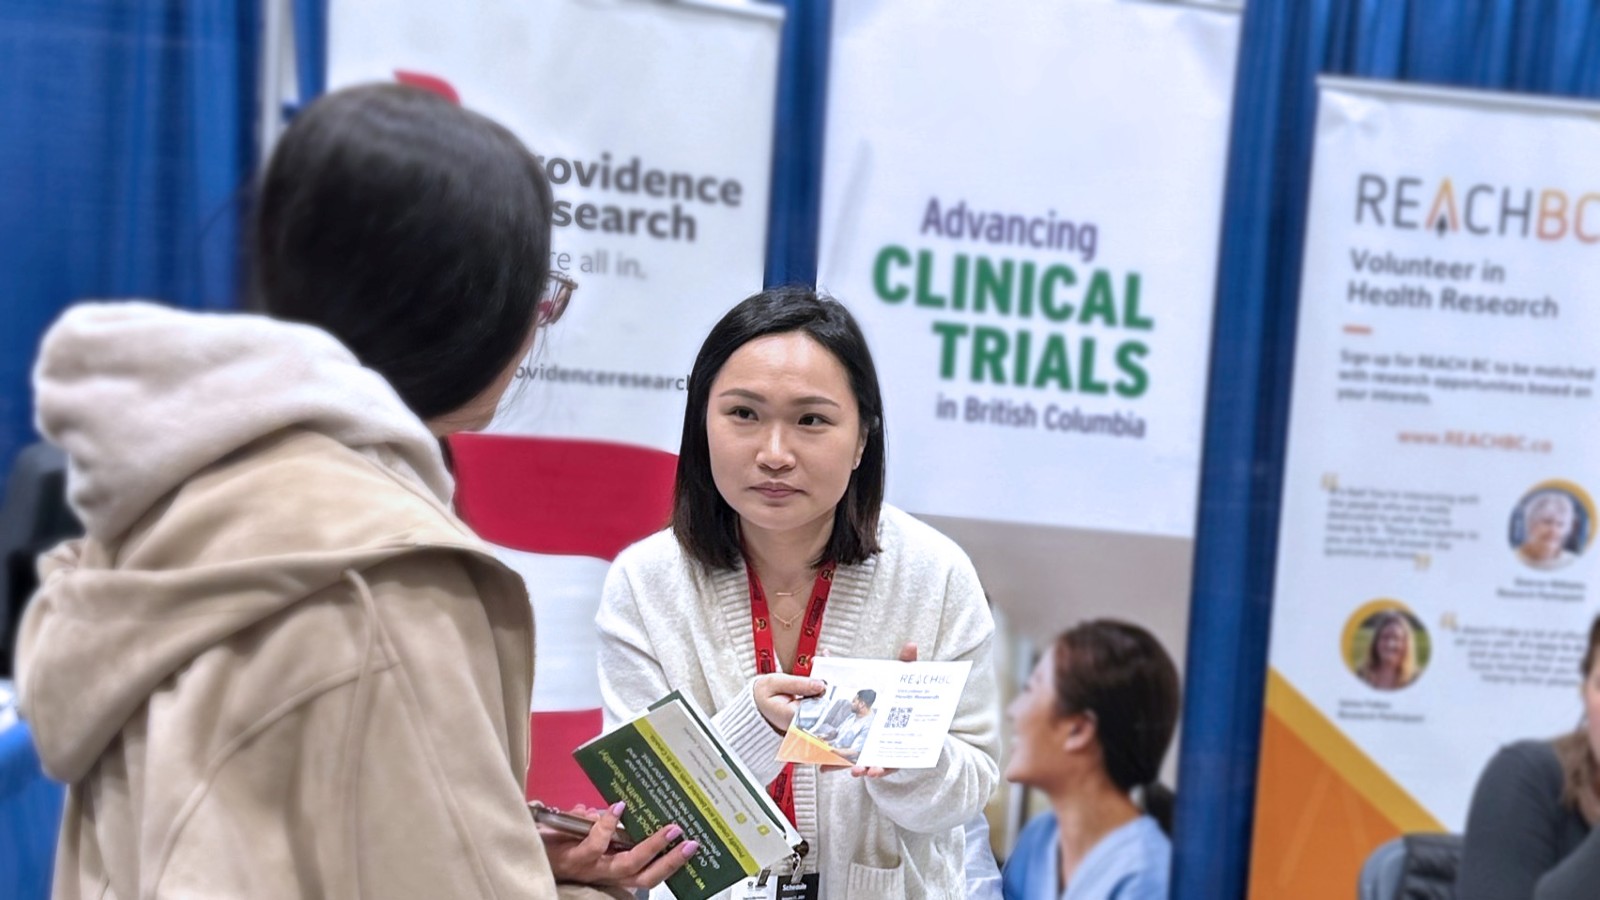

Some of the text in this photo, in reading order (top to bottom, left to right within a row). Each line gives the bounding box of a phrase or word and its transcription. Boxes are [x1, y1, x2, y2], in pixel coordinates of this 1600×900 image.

[535, 153, 742, 207] ovidence
[551, 200, 697, 242] search
[921, 196, 1098, 263] Advancing
[580, 250, 608, 275] all
[1350, 248, 1506, 284] Volunteer in
[873, 244, 1154, 331] CLINICAL
[1347, 279, 1559, 319] Health Research
[932, 321, 1150, 398] TRIALS
[1417, 355, 1467, 371] REACH
[1470, 359, 1489, 372] BC
[936, 394, 1146, 439] in British Columbia
[596, 747, 629, 785] naturally!
[623, 755, 640, 773] your
[638, 775, 653, 790] you
[641, 804, 660, 826] your
